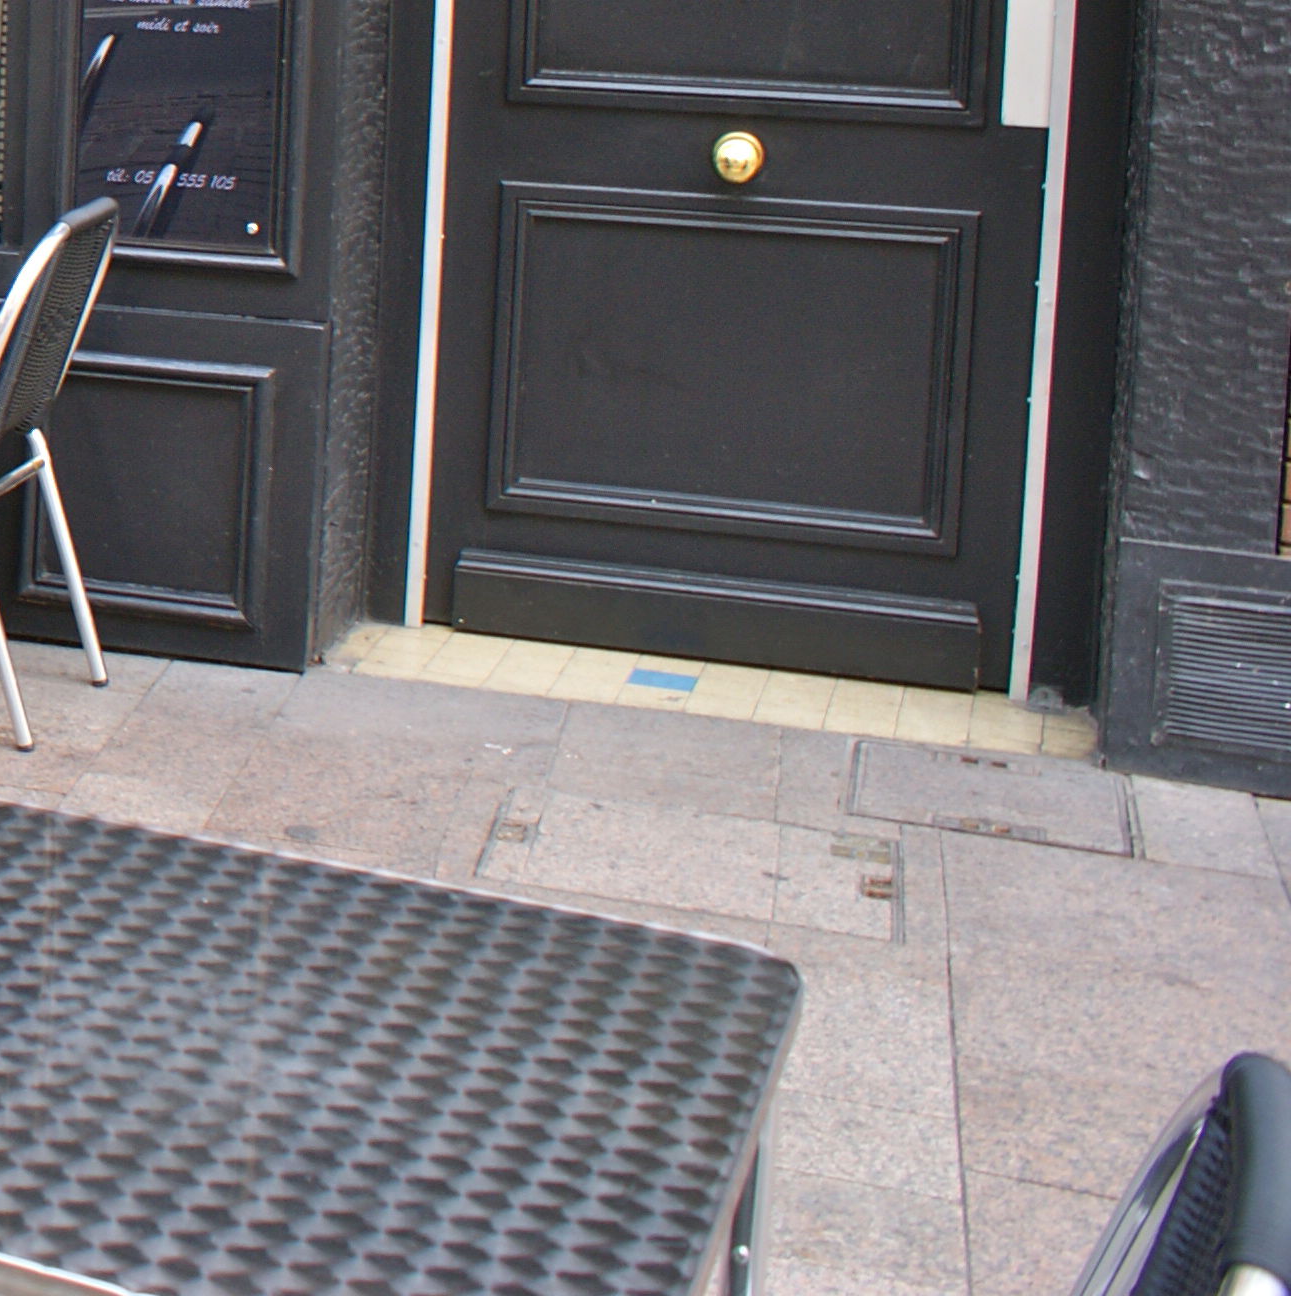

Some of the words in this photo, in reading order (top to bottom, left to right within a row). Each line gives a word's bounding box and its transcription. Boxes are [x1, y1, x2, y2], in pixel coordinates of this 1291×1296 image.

[136, 16, 170, 32] midi
[173, 20, 190, 33] et
[192, 22, 220, 35] soir
[133, 169, 156, 185] 05
[176, 173, 207, 188] 555
[209, 174, 237, 191] 105
